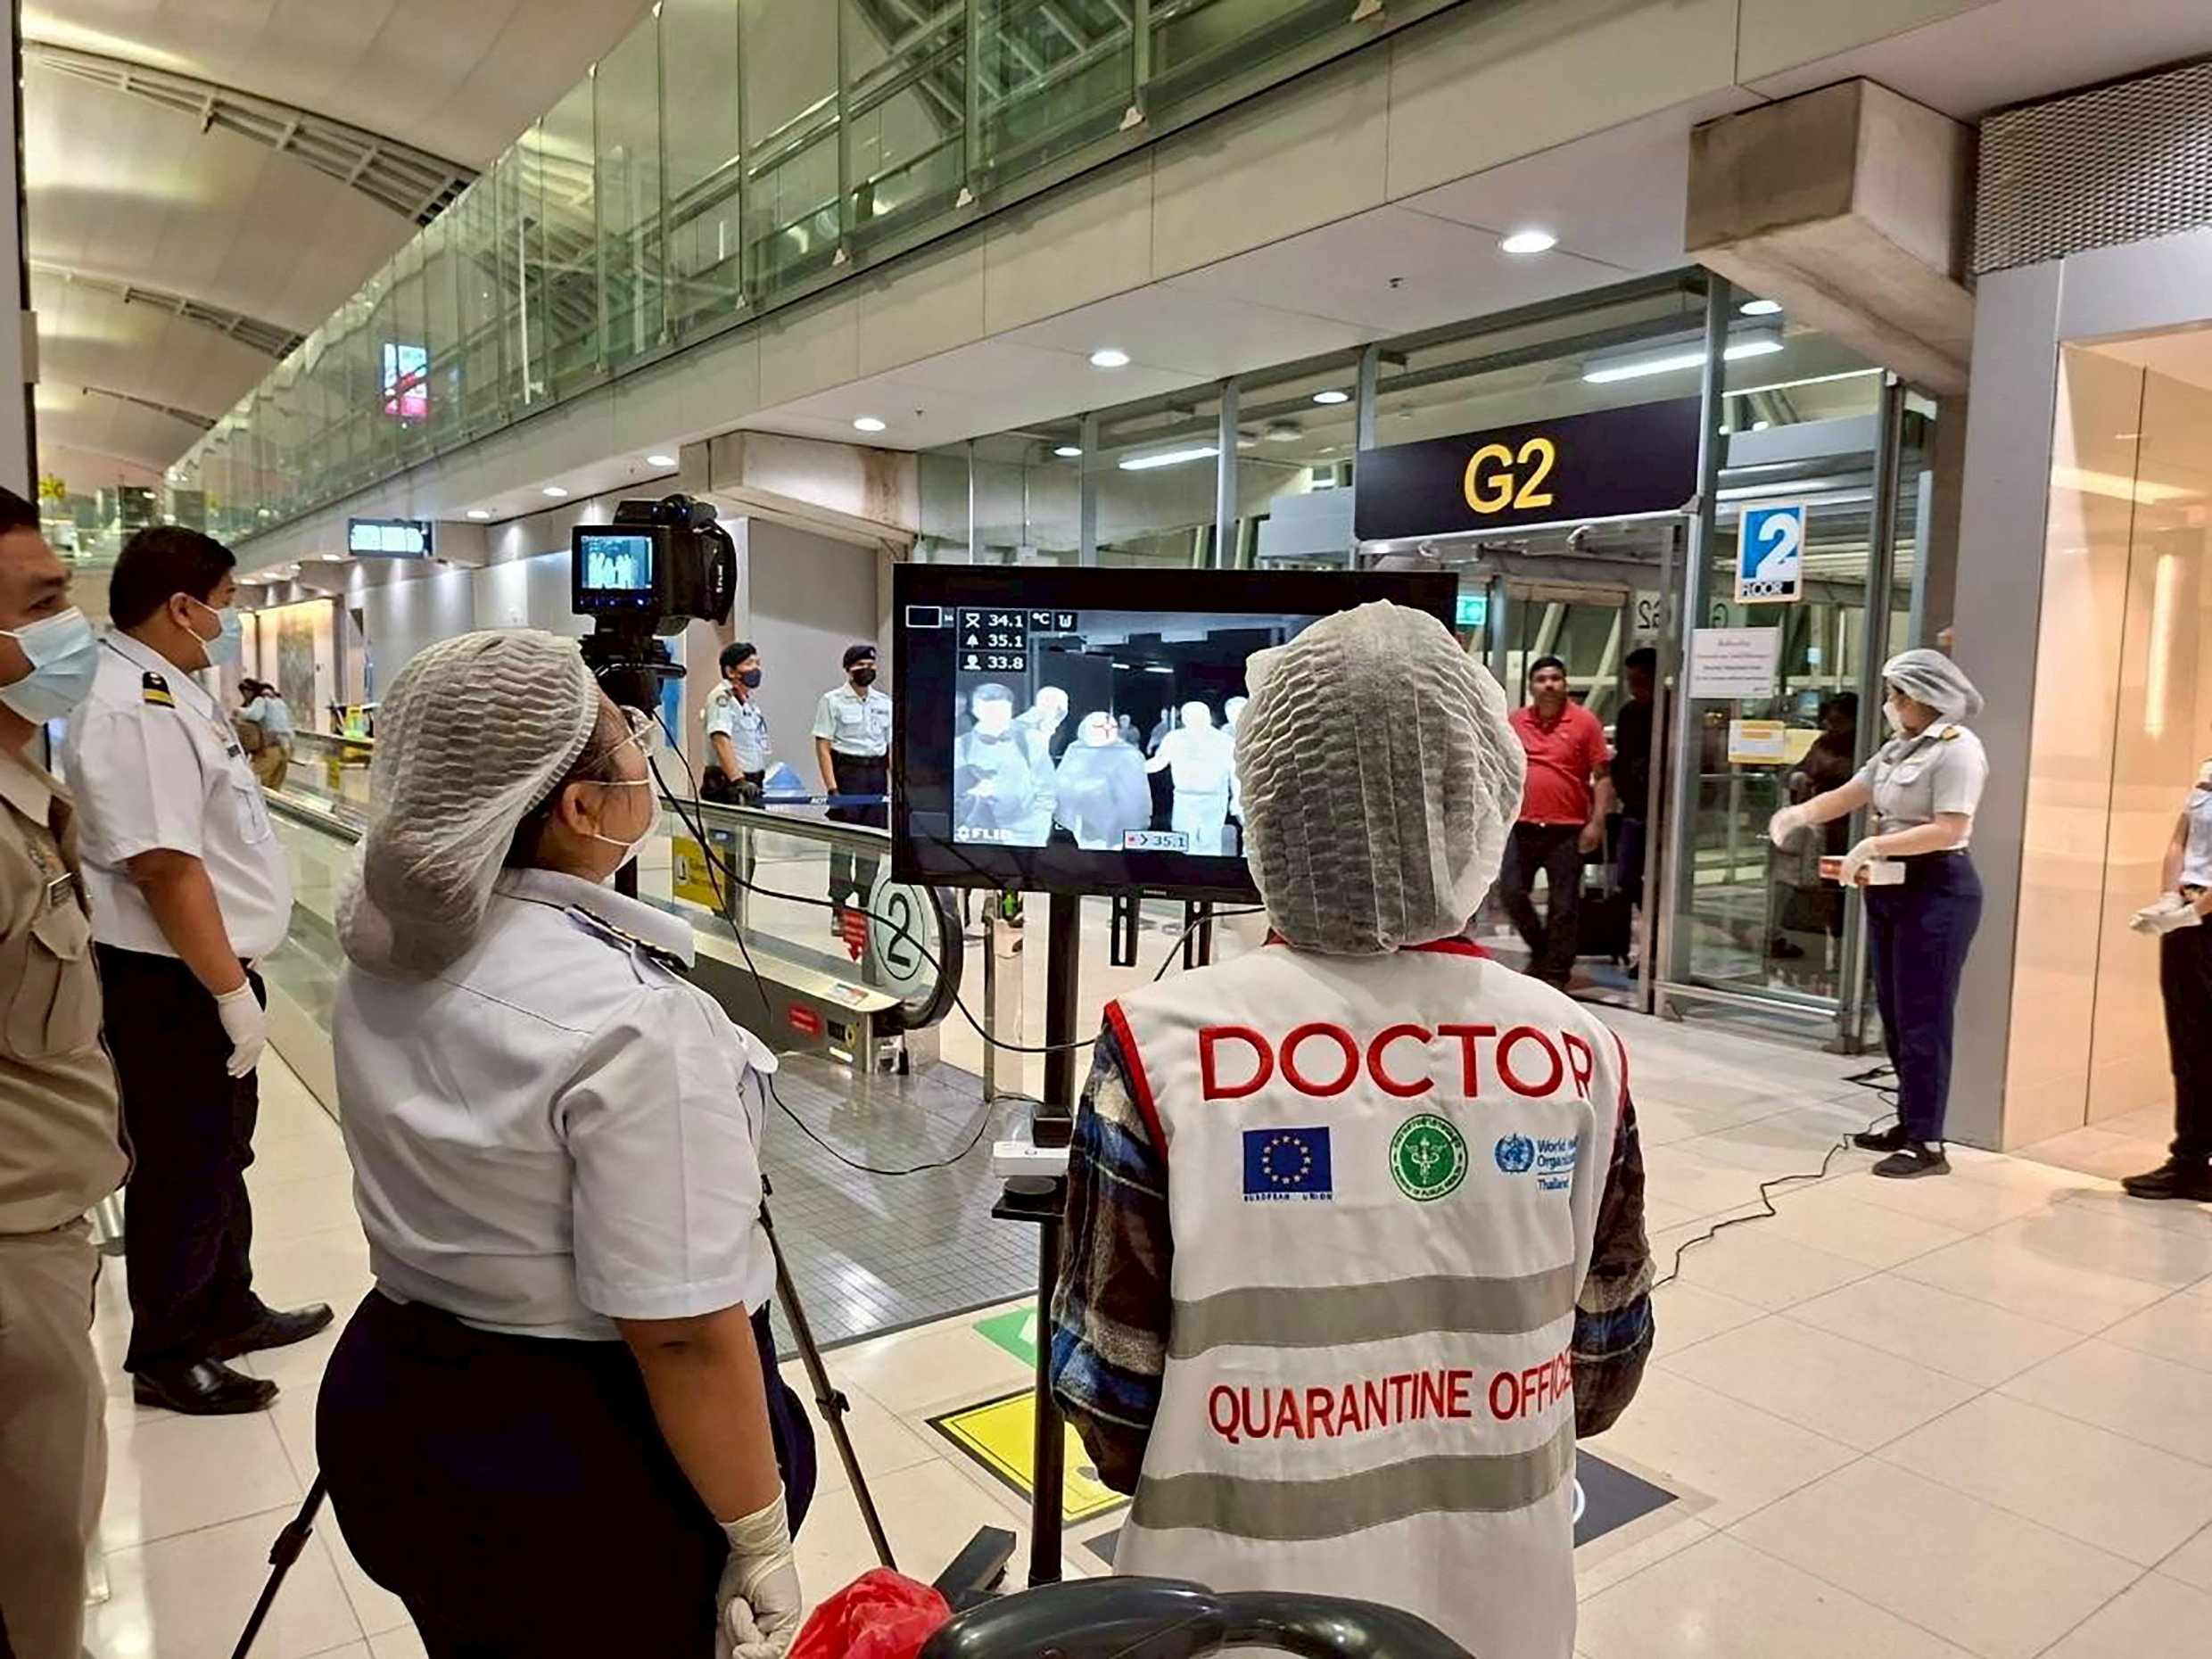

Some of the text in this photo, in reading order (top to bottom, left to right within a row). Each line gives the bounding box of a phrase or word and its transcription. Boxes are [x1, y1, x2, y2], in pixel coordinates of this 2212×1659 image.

[1463, 437, 1556, 515] G2
[1755, 513, 1799, 581] 2
[987, 614, 1024, 628] 34.1
[987, 634, 1024, 648] 35.1
[986, 656, 1024, 670] 33.8
[1154, 836, 1185, 848] 35.1
[887, 892, 912, 968] 2
[1198, 1022, 1593, 1101] DOCTOR
[1208, 1370, 1473, 1444] QUARANTINE
